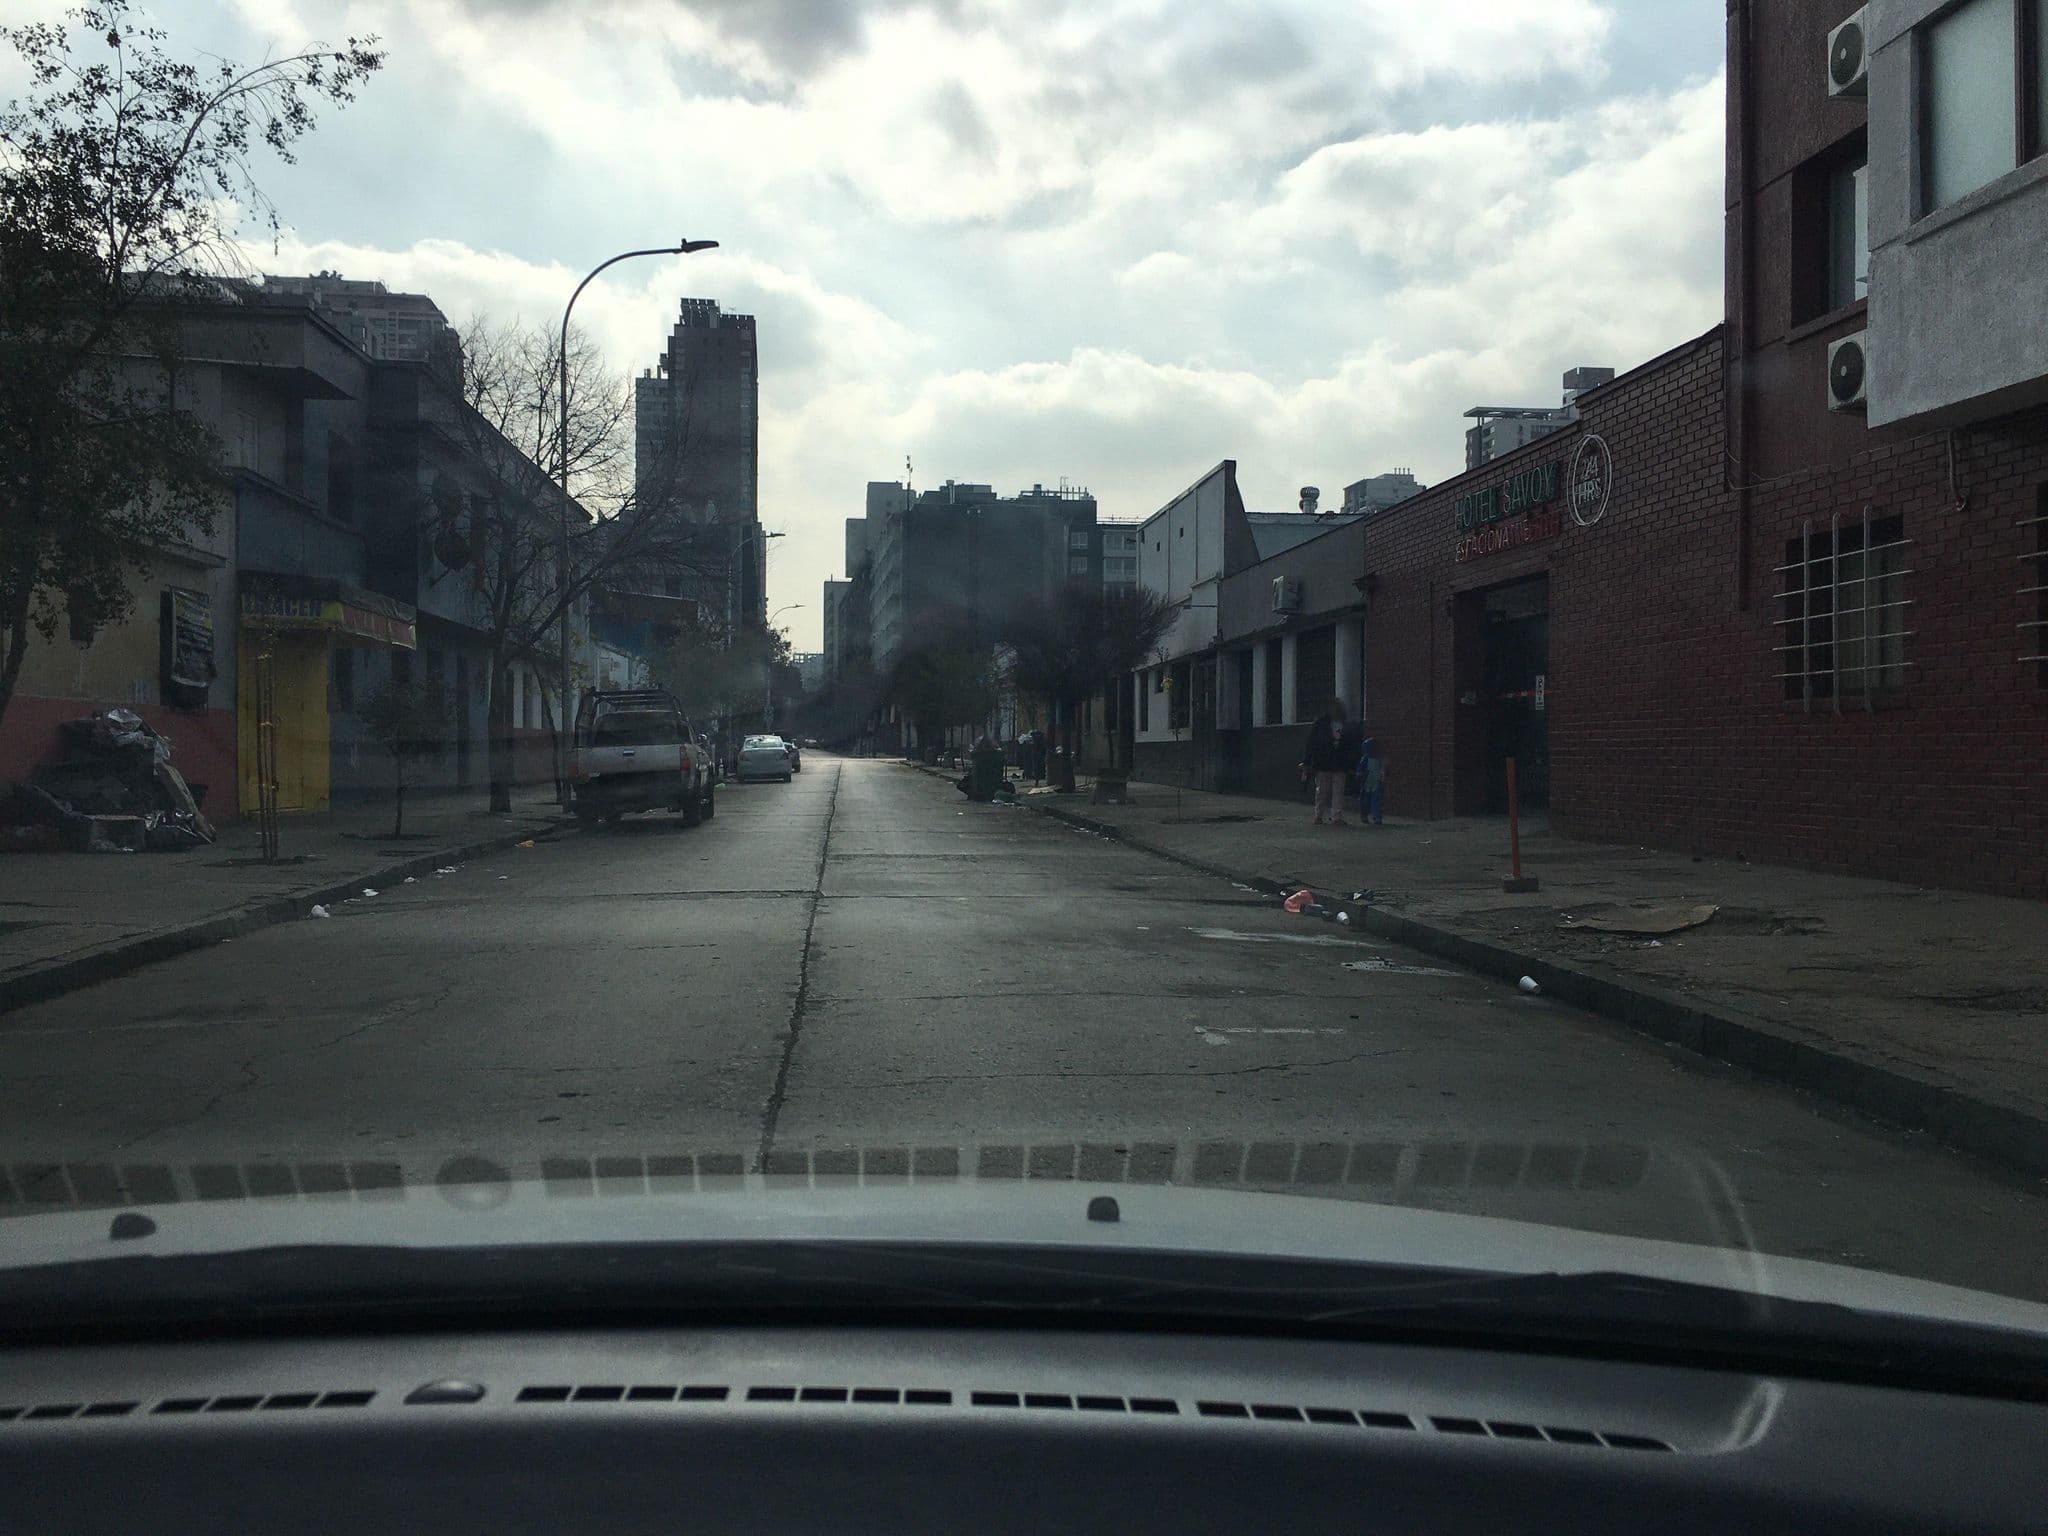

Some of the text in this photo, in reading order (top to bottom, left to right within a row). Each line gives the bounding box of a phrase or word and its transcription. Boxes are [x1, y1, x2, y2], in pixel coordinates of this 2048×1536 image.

[1582, 455, 1599, 479] 24
[1455, 463, 1554, 530] HOTEL SAVOY
